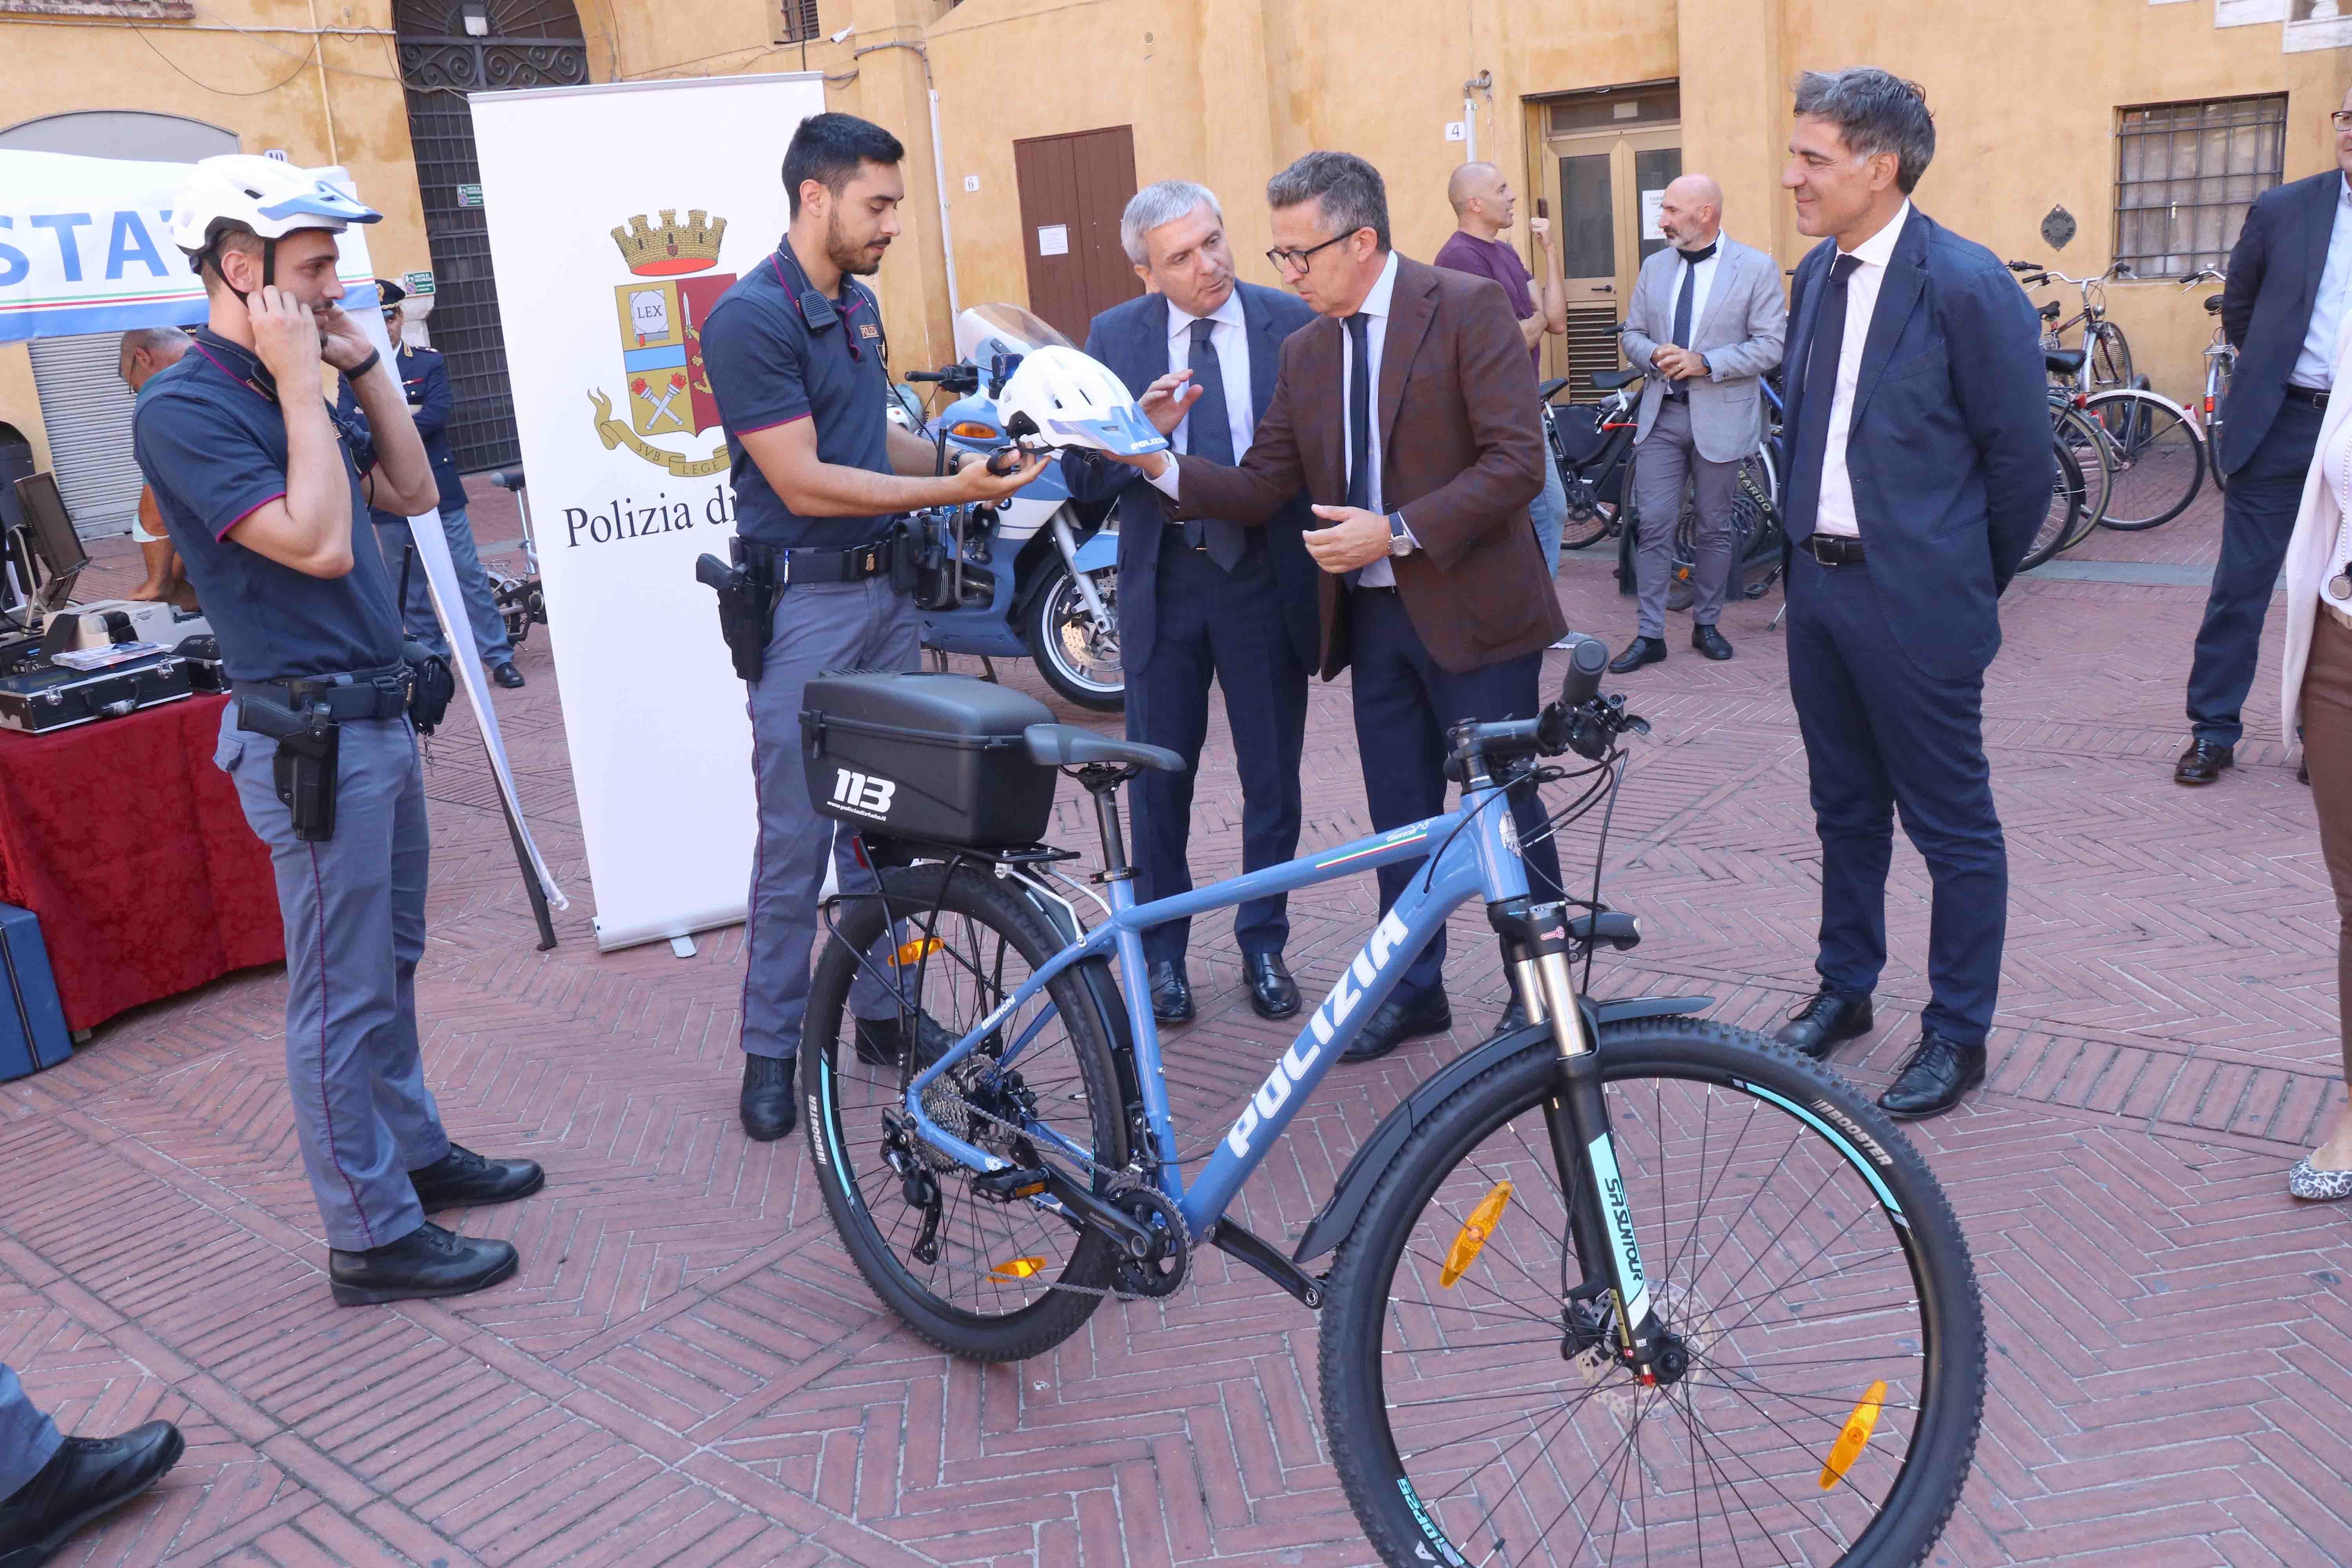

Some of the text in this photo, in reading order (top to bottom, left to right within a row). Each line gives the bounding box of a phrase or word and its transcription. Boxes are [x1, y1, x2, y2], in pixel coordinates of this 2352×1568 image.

[1452, 124, 1459, 137] 4
[968, 178, 974, 190] 6
[0, 210, 173, 287] STA
[637, 305, 663, 319] LEX
[636, 442, 661, 462] SVB
[682, 460, 720, 475] LEGE
[561, 492, 694, 548] Polizia
[1062, 601, 1071, 615] BMW
[833, 768, 896, 813] 113
[981, 994, 1016, 1030] Bianchi
[1227, 907, 1408, 1158] POLIZIA
[808, 1094, 824, 1152] BOOSTER
[1824, 1109, 1893, 1165] BOOSTER
[1604, 1178, 1624, 1208] SR
[1613, 1209, 1643, 1281] SUNTOUR
